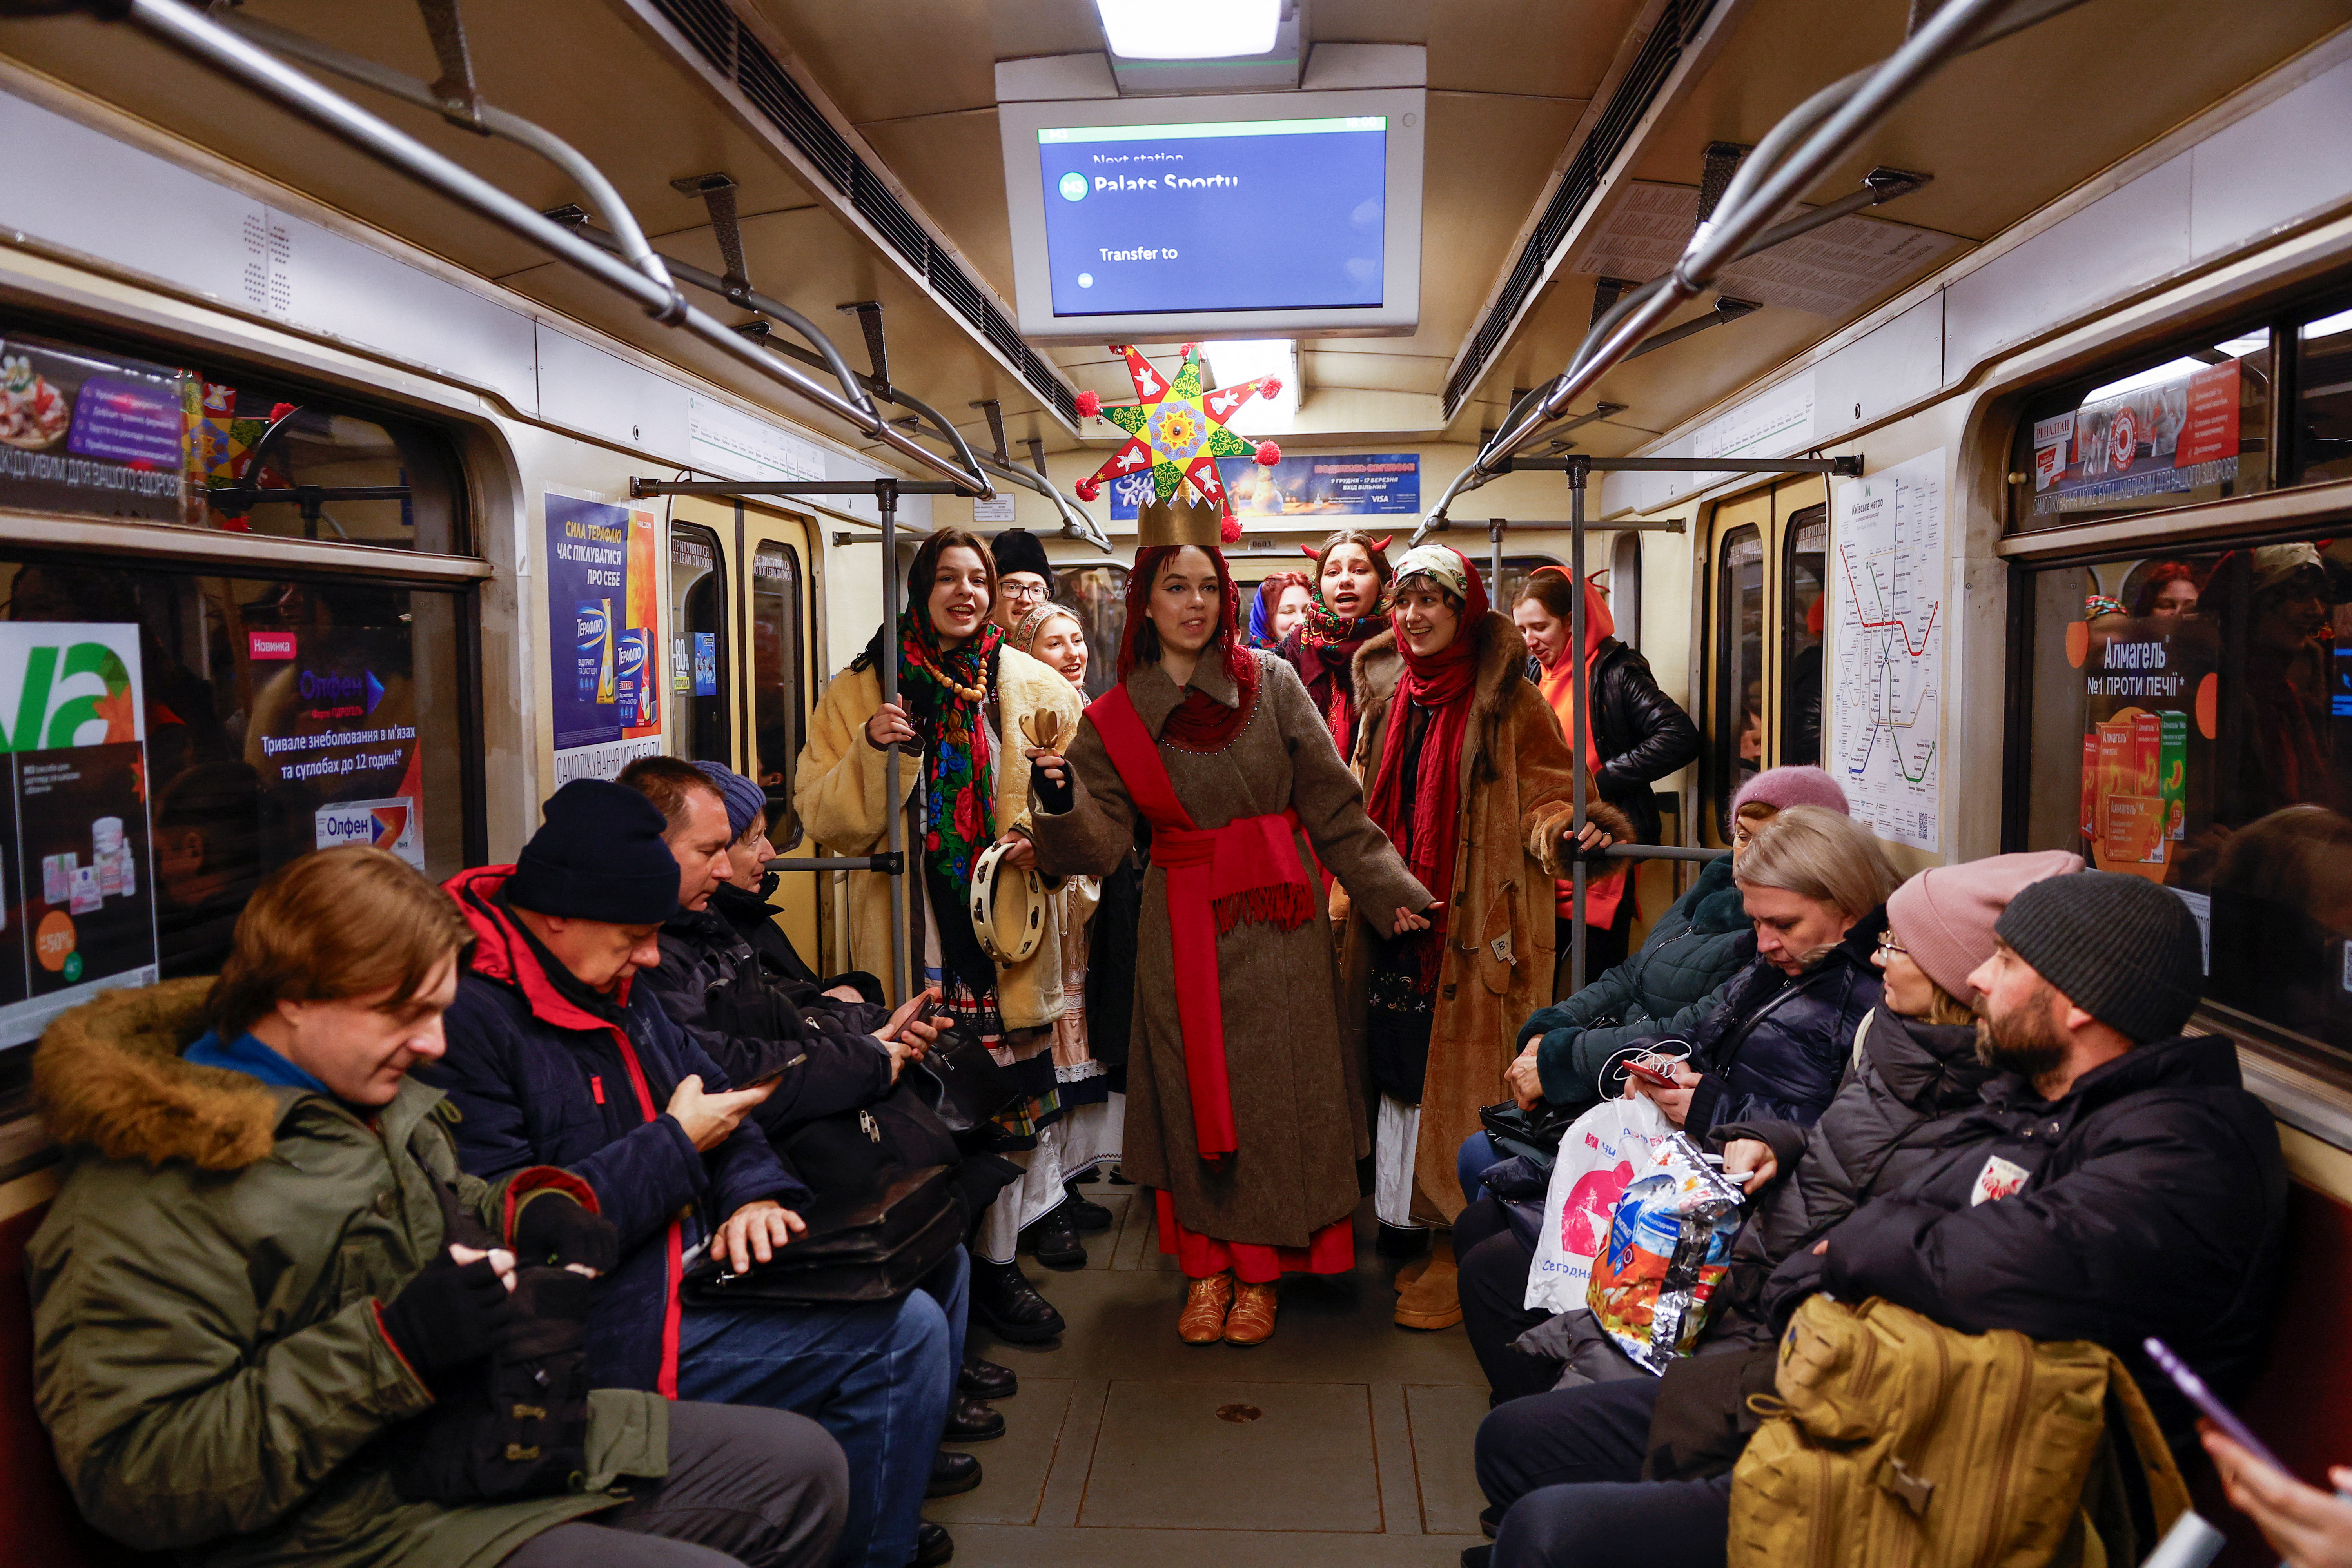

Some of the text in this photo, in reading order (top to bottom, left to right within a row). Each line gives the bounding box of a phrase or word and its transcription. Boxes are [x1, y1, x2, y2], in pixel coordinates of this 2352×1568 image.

[1063, 181, 1084, 193] M3
[1099, 246, 1178, 262] Transfer to
[2037, 419, 2070, 439] РЕНАЛГАН
[1852, 499, 1883, 515] Київське метро
[2033, 490, 2077, 515] САМОЛІКУВАННЯ
[2080, 486, 2096, 506] МОЖЕ
[565, 521, 622, 544] СИЛА ТЕРАФЛЮ
[1799, 522, 1826, 541] НЕ ПРИТУЛЯ
[557, 543, 621, 565] ЧАС ПІКЛУВАТИСЯ
[672, 539, 709, 557] ПРИТУЛЯТИСЯ
[679, 552, 691, 565] LEAN
[692, 555, 699, 567] ON
[700, 557, 712, 569] DOOR
[755, 555, 790, 570] НЕ ПРИТУЛЯТИСЯ
[587, 569, 621, 587] ПРО СЕБЕ
[767, 567, 776, 578] LEAN
[777, 569, 782, 579] ON
[782, 570, 792, 581] DOOR
[254, 639, 290, 652] Новинка
[673, 638, 690, 671] -80%
[2104, 637, 2166, 669] Алмагель
[299, 670, 362, 704] Олфен
[621, 681, 633, 689] ЕКСТРА
[2087, 672, 2178, 696] №1 ПРОТИ ПЕЧІЇ
[261, 724, 416, 757] Тривале знеболювання в м'язах
[2103, 731, 2127, 743] Алмагель
[281, 767, 293, 780] та
[295, 757, 339, 781] суглобах
[341, 760, 353, 775] до
[356, 753, 367, 770] 12
[557, 748, 619, 784] САМОЛІКУВАННЯ
[327, 817, 368, 839] Олфен
